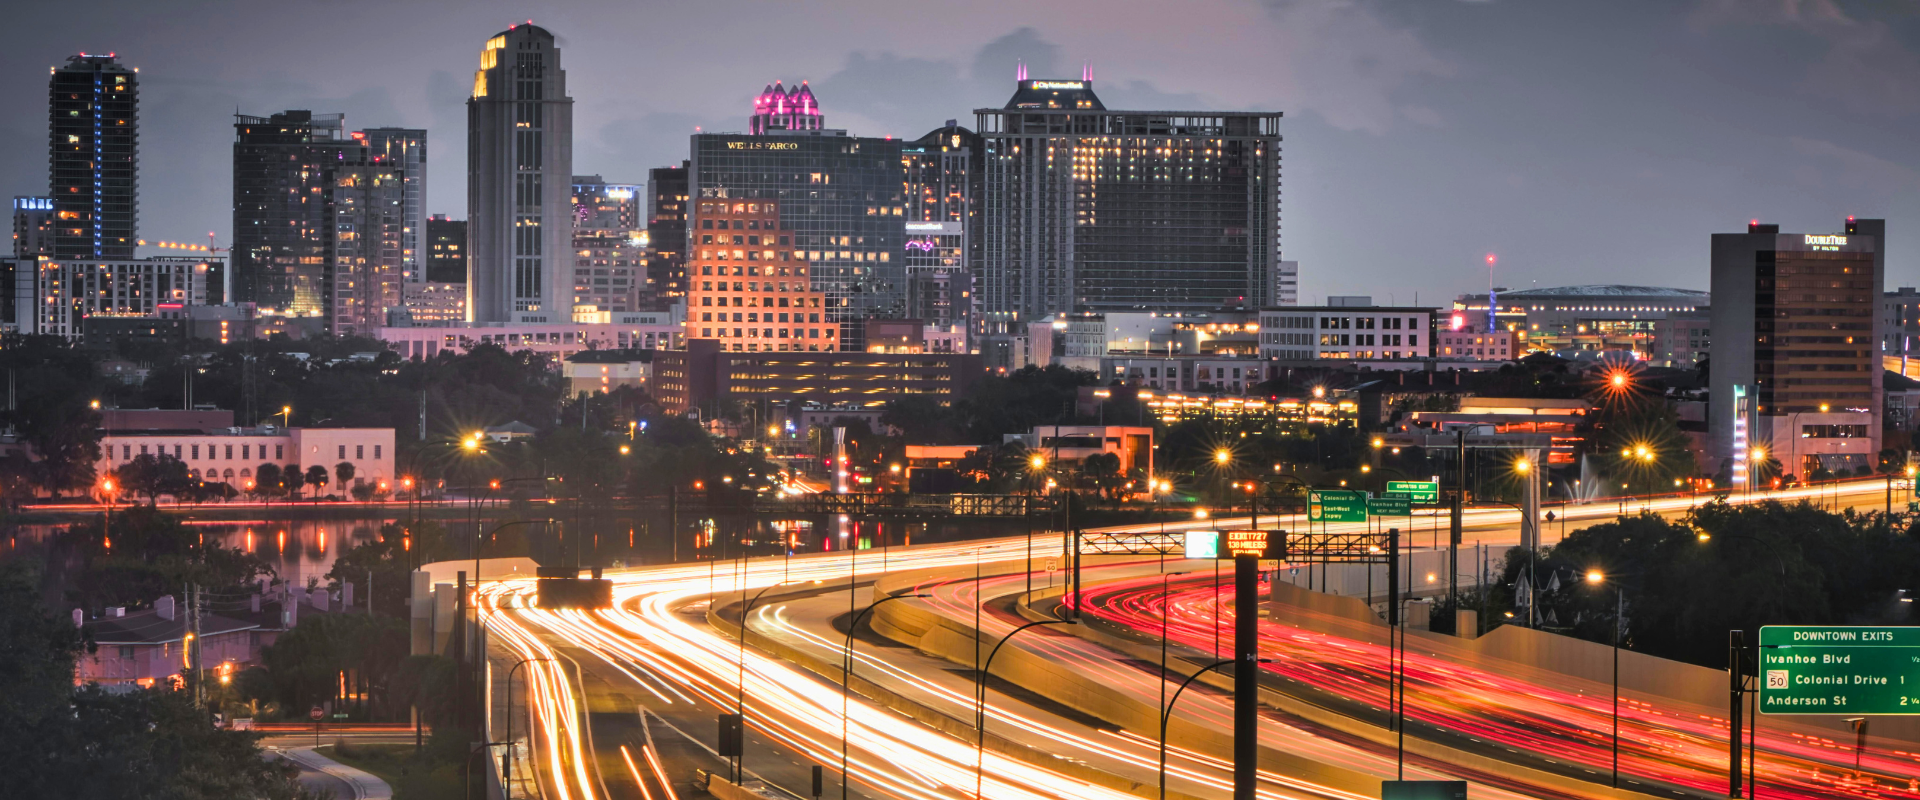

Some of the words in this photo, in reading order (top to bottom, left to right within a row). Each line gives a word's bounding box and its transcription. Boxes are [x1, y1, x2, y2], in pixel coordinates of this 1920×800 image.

[1794, 632, 1856, 641] DOWNTOWN
[1862, 632, 1893, 641] EXITS
[1766, 654, 1816, 664] Ivanhoe
[1823, 654, 1850, 664] Blvd
[1770, 677, 1784, 686] 50
[1796, 675, 1848, 685] Colonial
[1854, 675, 1887, 685] Drive
[1900, 675, 1904, 684] 1
[1766, 696, 1827, 705] Anderson
[1833, 696, 1847, 705] St
[1900, 696, 1908, 705] 2
